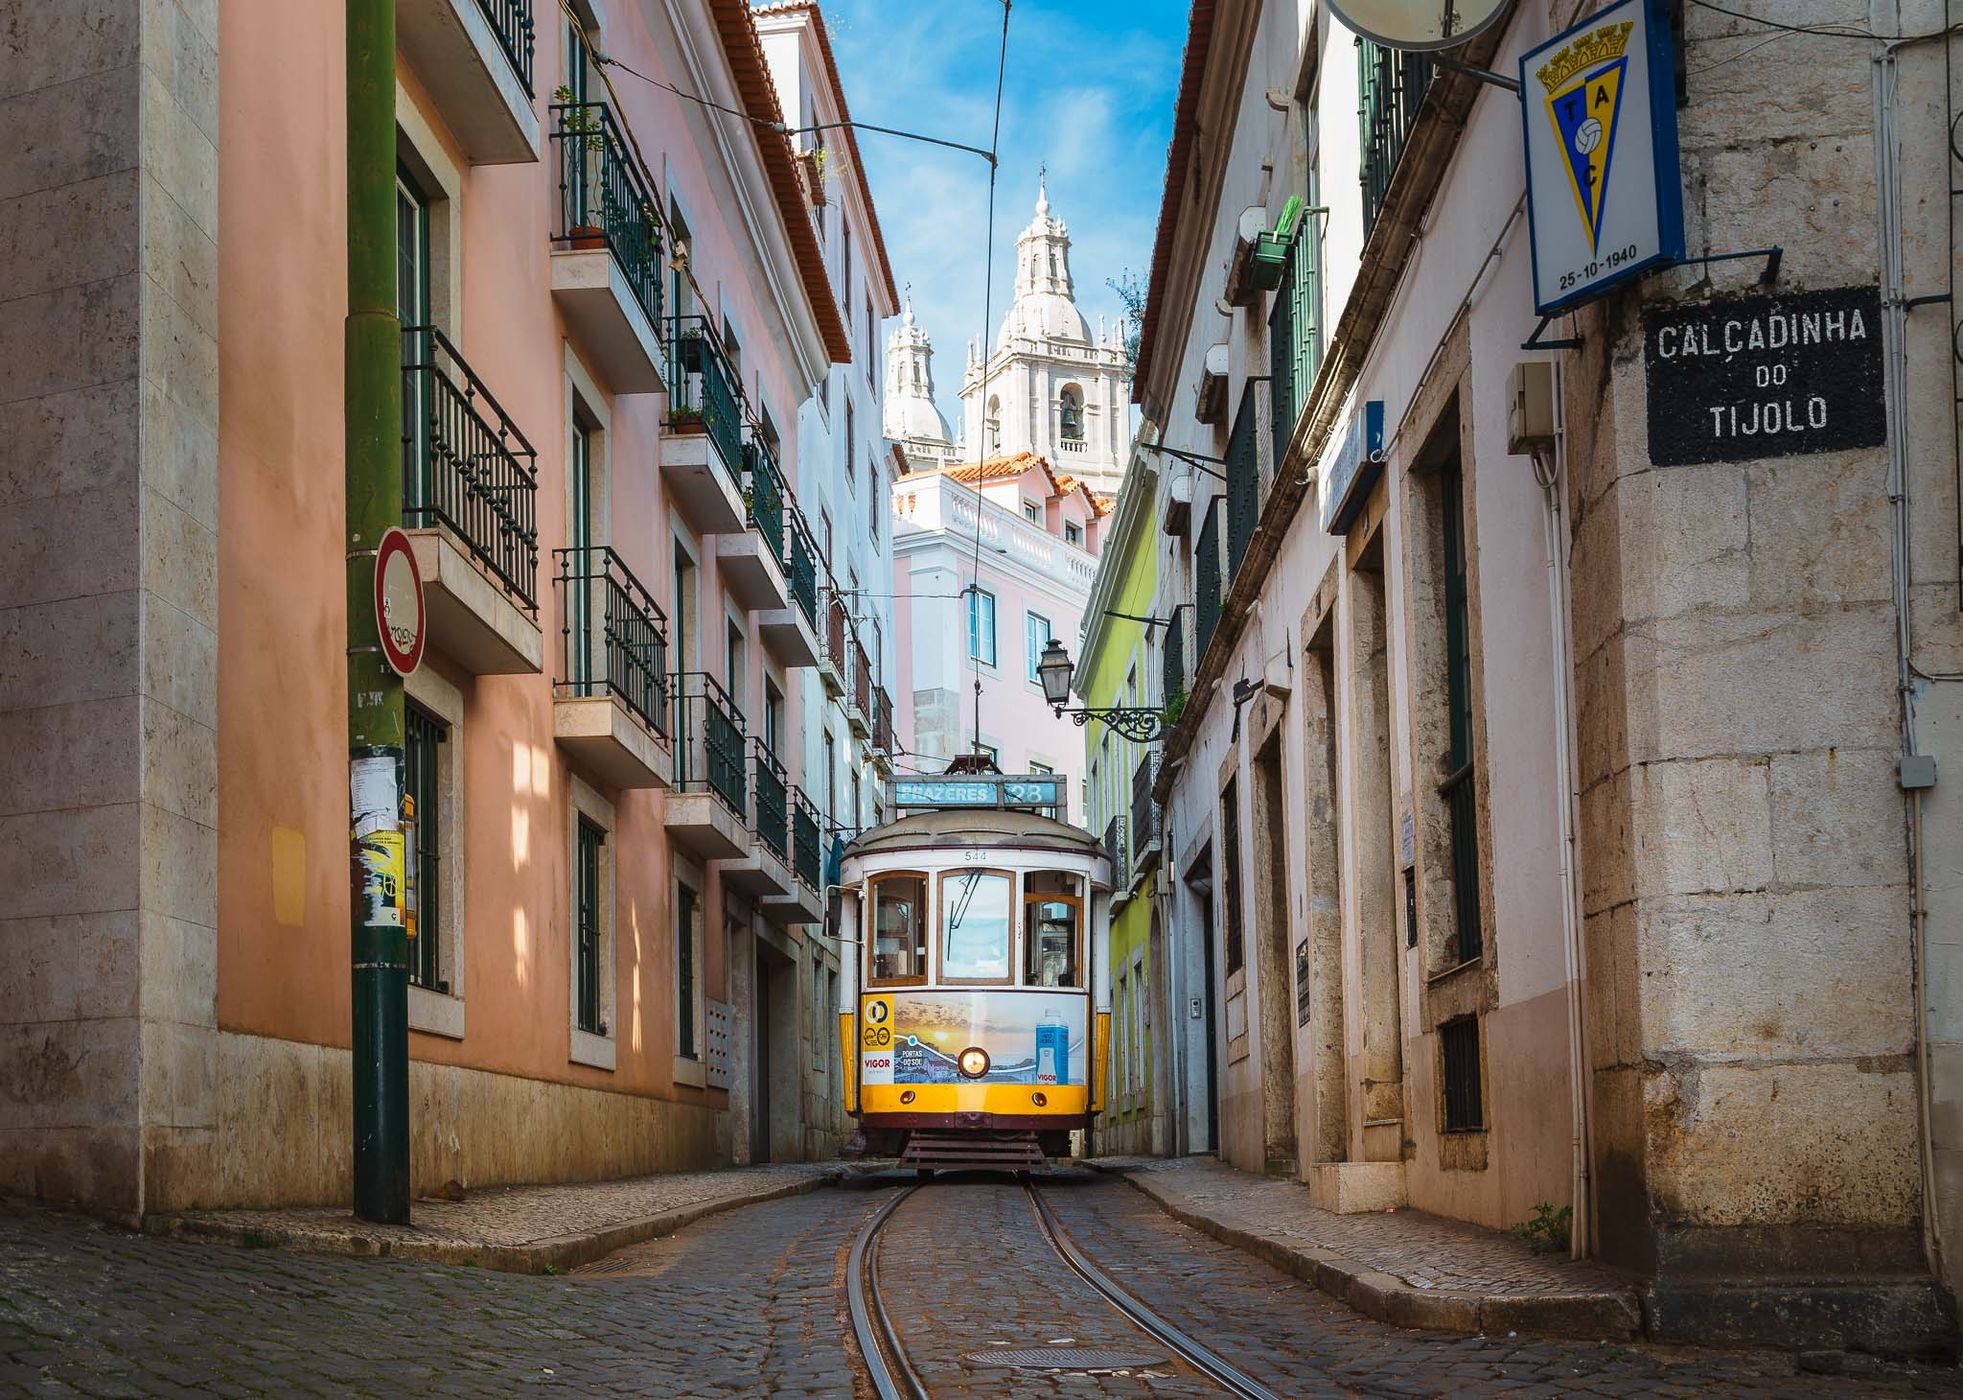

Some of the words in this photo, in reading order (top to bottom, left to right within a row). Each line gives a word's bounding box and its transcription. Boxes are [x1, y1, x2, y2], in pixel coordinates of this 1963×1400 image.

[1564, 99, 1577, 123] T
[1595, 84, 1610, 109] A
[1584, 164, 1597, 188] C
[1559, 243, 1638, 292] 25-10-1940
[1658, 308, 1867, 363] CALÇADINHA
[1756, 364, 1787, 388] DO
[1709, 397, 1828, 438] TIJOLO
[901, 785, 989, 802] PRAZERES
[964, 850, 987, 861] 544
[864, 1058, 891, 1069] VIGOR
[902, 1050, 923, 1058] PORTAS
[1037, 1073, 1057, 1082] VIGOR
